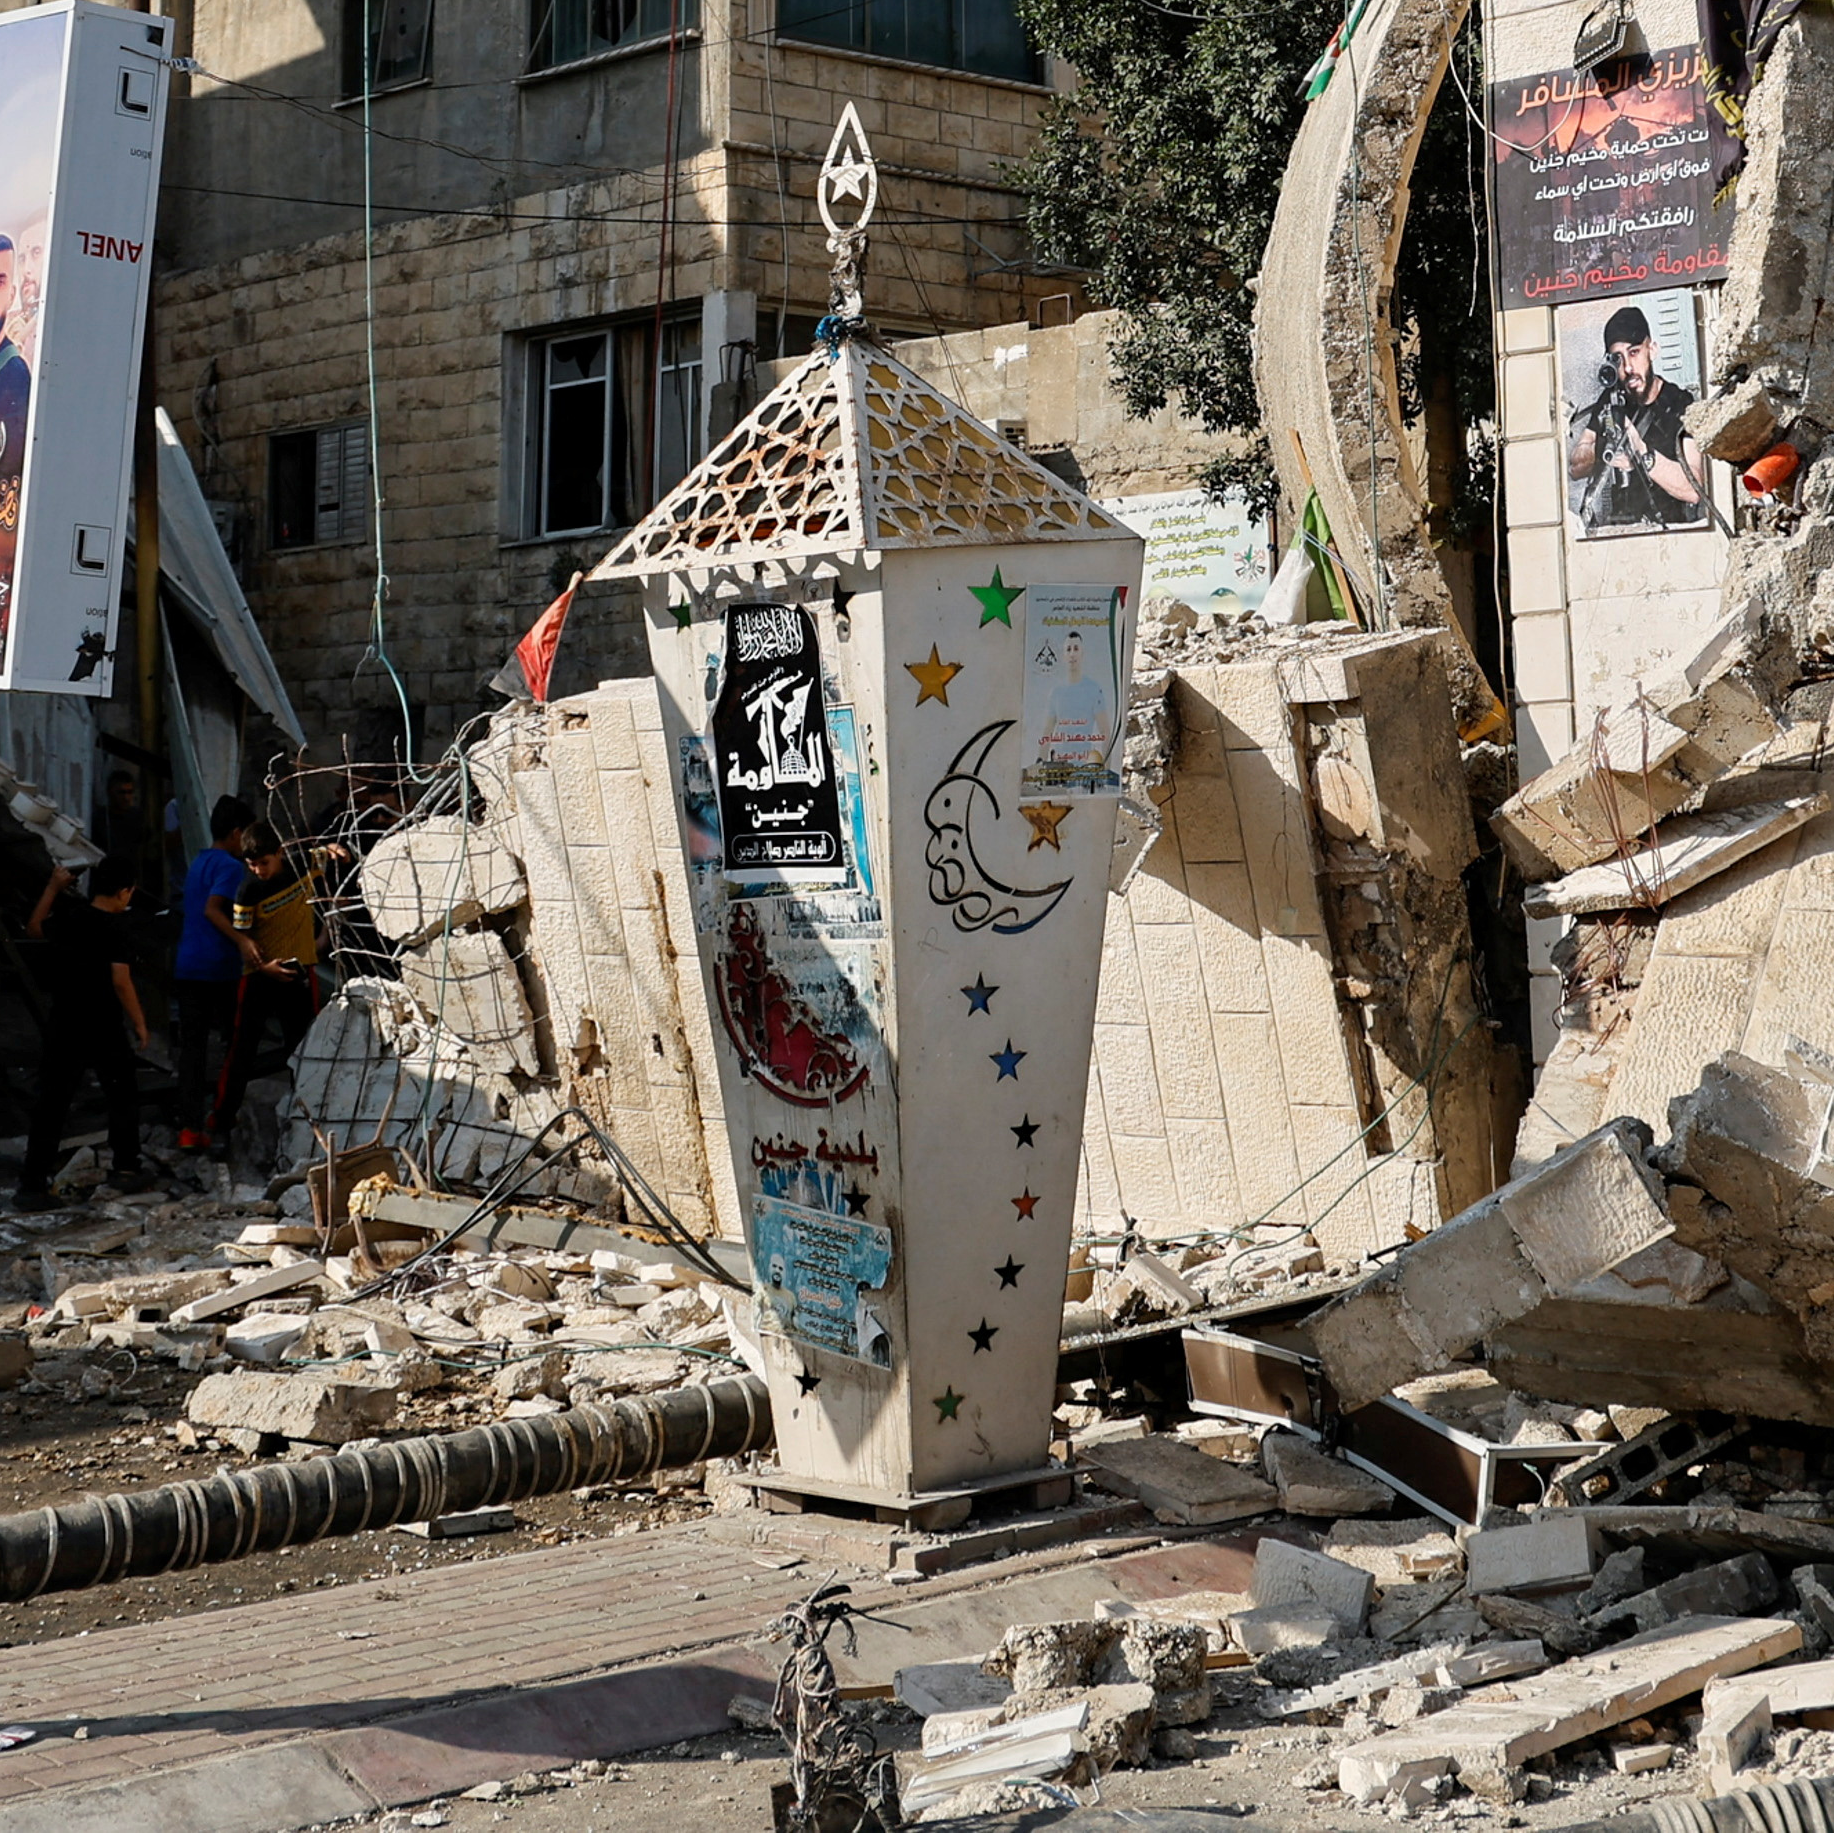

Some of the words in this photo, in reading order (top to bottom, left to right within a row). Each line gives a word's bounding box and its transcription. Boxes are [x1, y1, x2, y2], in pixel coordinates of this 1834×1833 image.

[1639, 47, 1703, 103] زيزي
[1516, 60, 1631, 117] المسافر
[1610, 141, 1649, 161] حماية
[1652, 129, 1686, 150] تحت
[1529, 155, 1565, 174] جنين
[1566, 149, 1609, 169] مخيم
[1680, 157, 1711, 179] فوق
[1534, 185, 1569, 202] سماء
[1590, 172, 1628, 192] وتحت
[1553, 219, 1619, 244] السلامة
[1619, 205, 1695, 238] رافقتكم
[1523, 269, 1579, 299] جنين
[1583, 260, 1648, 290] مخيم
[751, 1132, 810, 1170] جنين
[815, 1128, 880, 1177] بلدية
